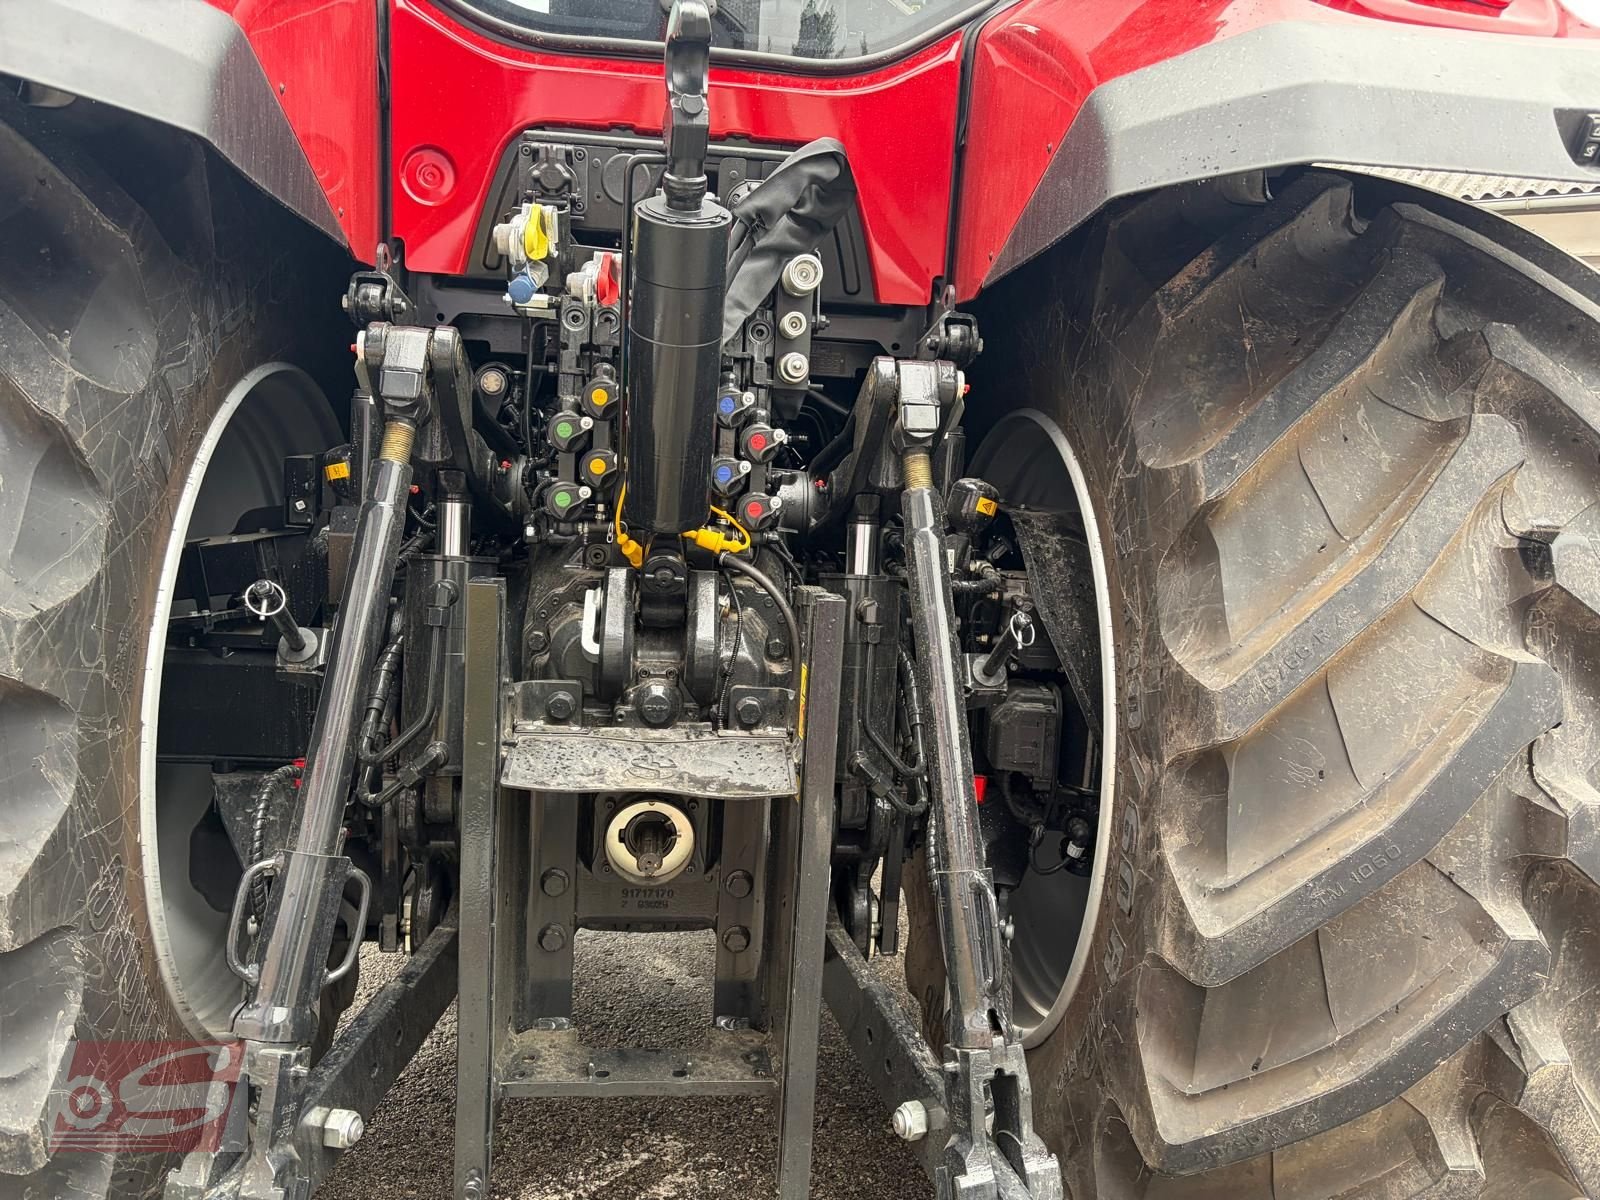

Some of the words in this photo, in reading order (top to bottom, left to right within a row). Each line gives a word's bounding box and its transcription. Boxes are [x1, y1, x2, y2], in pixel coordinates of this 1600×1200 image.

[621, 887, 674, 899] 91717170
[1313, 882, 1348, 908] TM
[1350, 844, 1402, 885] 1060
